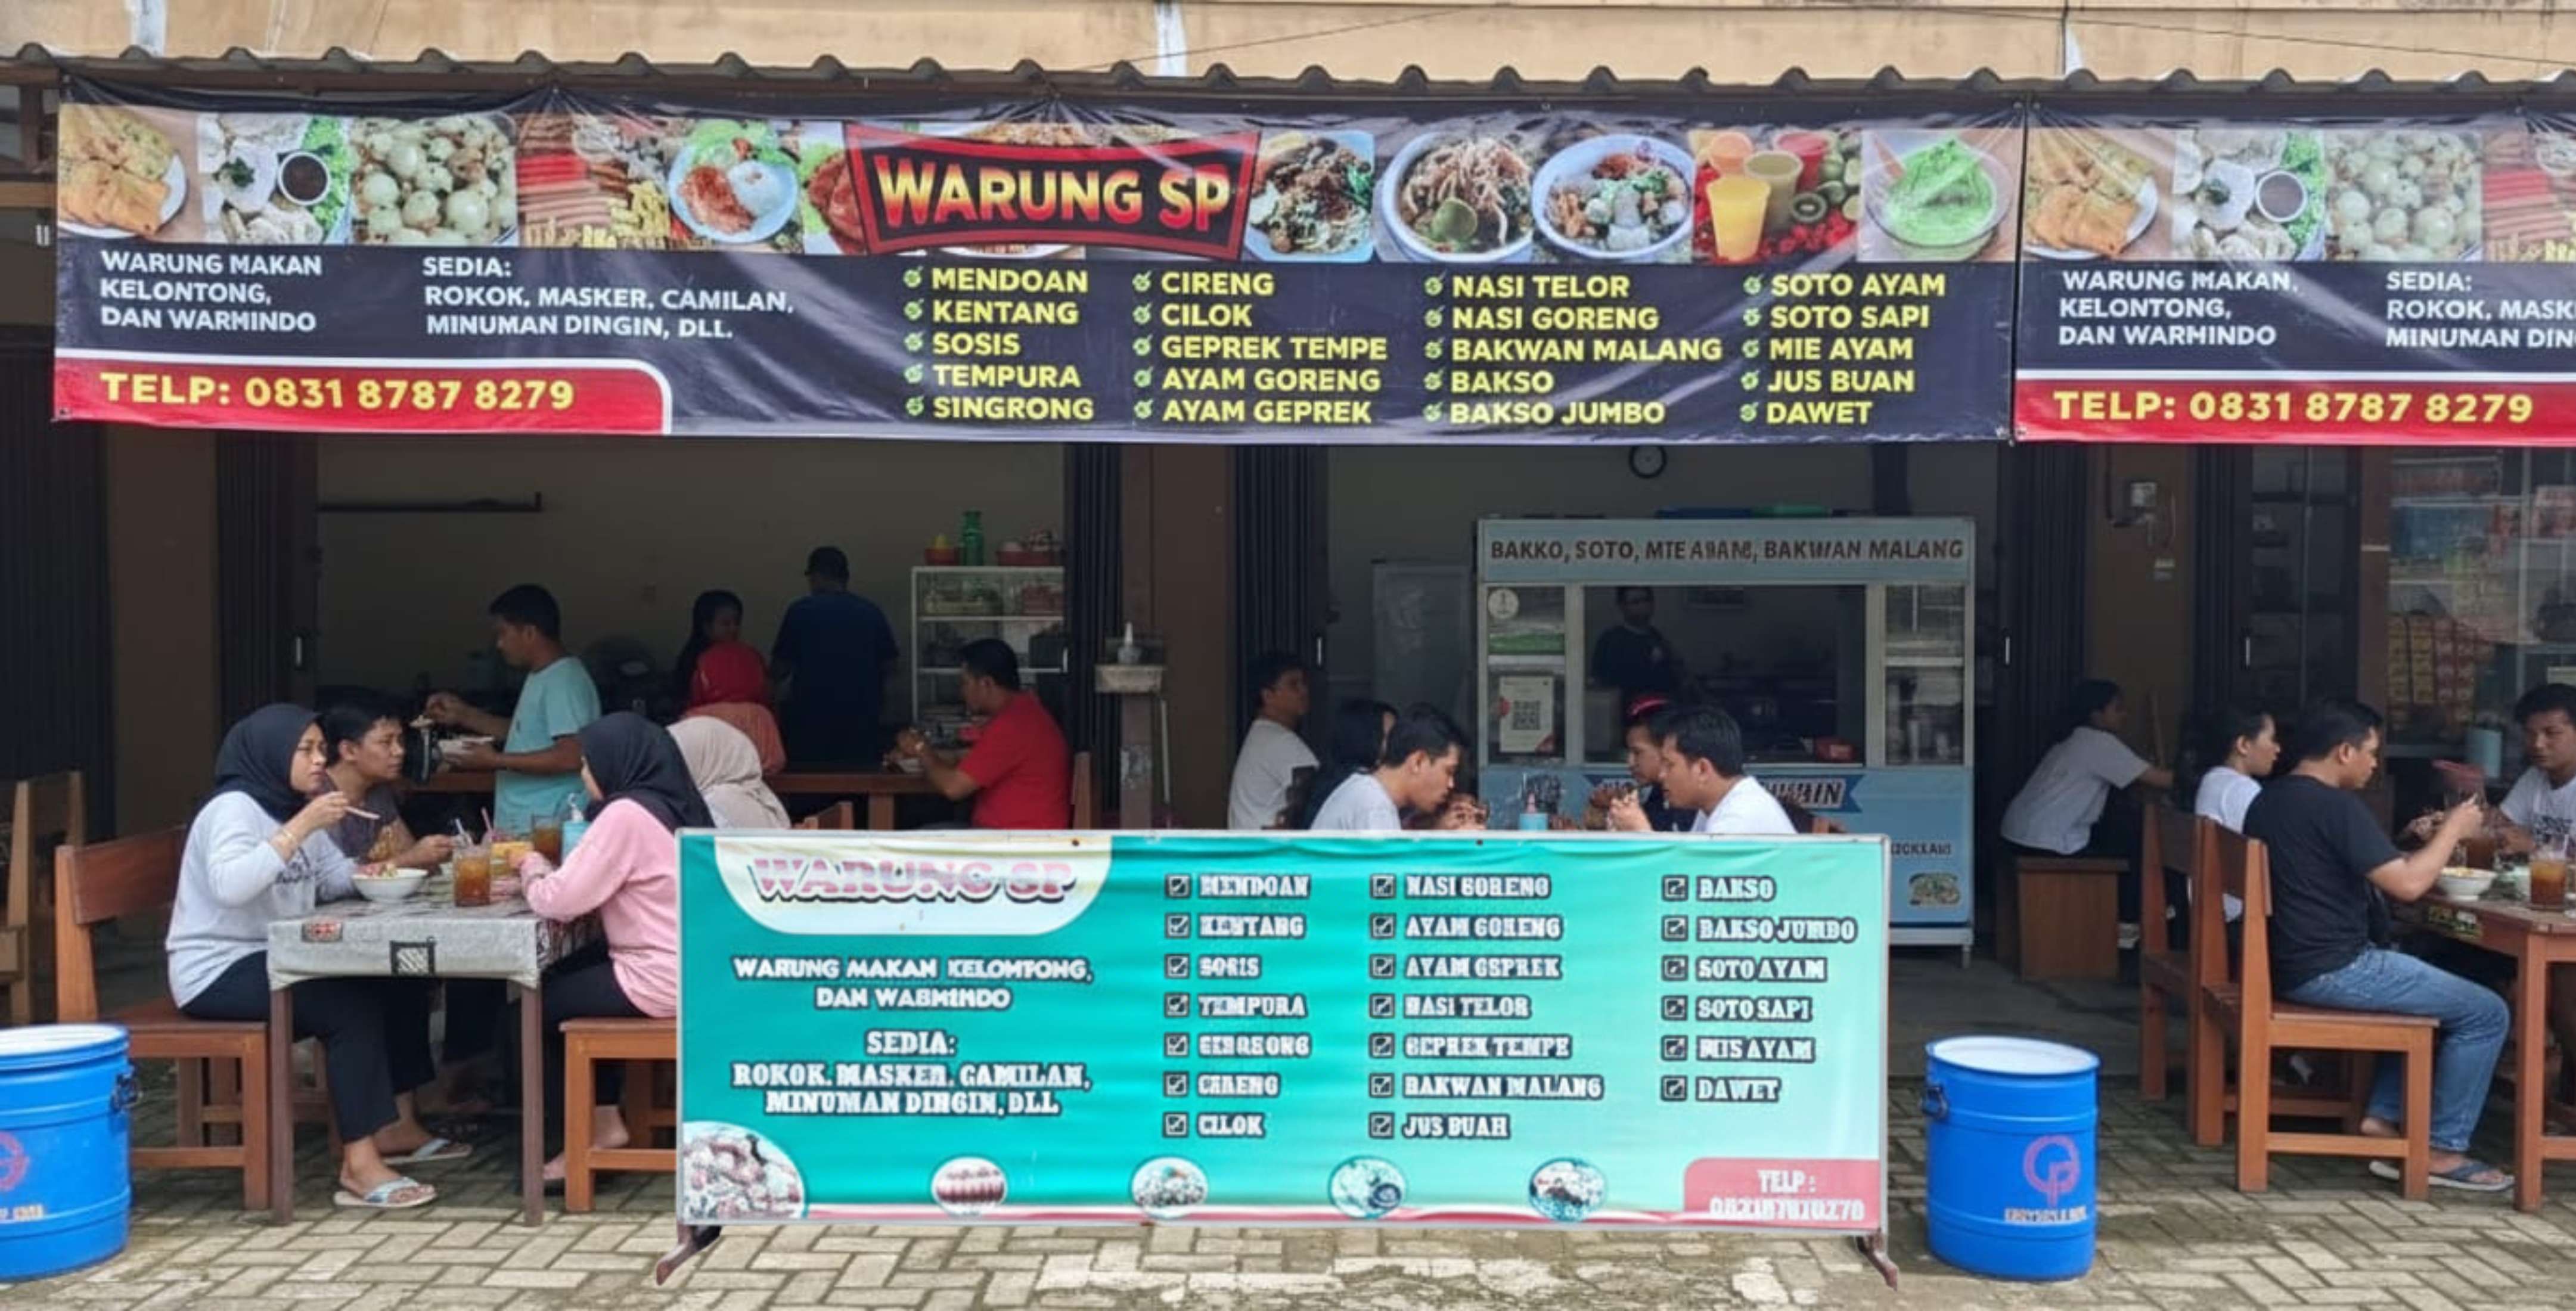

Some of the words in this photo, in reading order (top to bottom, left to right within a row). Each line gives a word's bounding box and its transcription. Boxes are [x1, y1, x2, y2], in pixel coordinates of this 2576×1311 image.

[874, 154, 1143, 230] WARUNG
[1158, 163, 1231, 231] SP
[101, 249, 223, 275] WARUNG
[230, 251, 322, 276] MAKAN
[423, 257, 512, 277] SEDIA:
[100, 279, 272, 305] KELONTONG,
[932, 268, 1089, 293] MENDOAN
[1161, 272, 1275, 297] CIRENG
[1452, 275, 1523, 299] NASI
[1532, 274, 1630, 299] TELOR
[1770, 274, 1853, 297] SOTO
[1861, 274, 1946, 297] AYAM
[2062, 270, 2185, 291] WARUNG
[2385, 271, 2473, 291] SEDIA:
[101, 307, 157, 329] DAN
[165, 308, 316, 332] WARMINDO
[932, 299, 1079, 324] KENTANG
[1161, 303, 1252, 327] CILOK
[1452, 307, 1523, 330] NASI
[1532, 306, 1659, 330] GORENG
[1770, 305, 1852, 328] SOTO
[1860, 305, 1930, 328] SAPI
[2059, 297, 2232, 320] KELONTONG,
[2499, 299, 2576, 320] MASK
[427, 315, 558, 335] MINUMAN
[564, 315, 669, 340] DINGIN,
[678, 319, 733, 338] DLL.
[2058, 325, 2115, 346] DAN
[2385, 327, 2519, 348] MINUMAN
[2527, 327, 2576, 348] DIN
[932, 332, 1021, 356] SOSIS
[1161, 336, 1281, 361] GEPREK
[1289, 337, 1388, 361] TEMPE
[1451, 338, 1584, 362] BAKWAN
[1593, 337, 1723, 362] MALANG
[1769, 338, 1822, 360] MIE
[1826, 338, 1914, 361] AYAM
[932, 364, 1081, 389] TEMPURA
[1161, 368, 1245, 391] AYAM
[1253, 368, 1382, 392] GORENG
[1450, 369, 1554, 393] BAKSO
[1768, 370, 1823, 393] JUS
[100, 373, 230, 404] TELP:
[245, 377, 344, 408] 0831
[358, 378, 463, 409] 8787
[474, 380, 574, 409] 8279
[932, 396, 1094, 421] SINGRONG
[1162, 399, 1245, 422] AYAM
[1253, 400, 1372, 424] GEPREK
[1449, 401, 1554, 424] BAKSO
[1561, 401, 1665, 425] JUMBO
[1767, 402, 1873, 424] DAWET
[2053, 390, 2175, 420] TELP:
[2189, 392, 2291, 421] 0831
[2305, 392, 2413, 422] 8787
[2425, 393, 2533, 422] 8279
[1574, 540, 1640, 564] SOTO,
[1764, 539, 1862, 560] BAKWAN
[1869, 539, 1964, 560] MALANG
[733, 957, 841, 980] WARUNG
[846, 957, 937, 979] MAKAN
[815, 986, 868, 1008] DAN
[865, 1030, 956, 1055] SEDIA:
